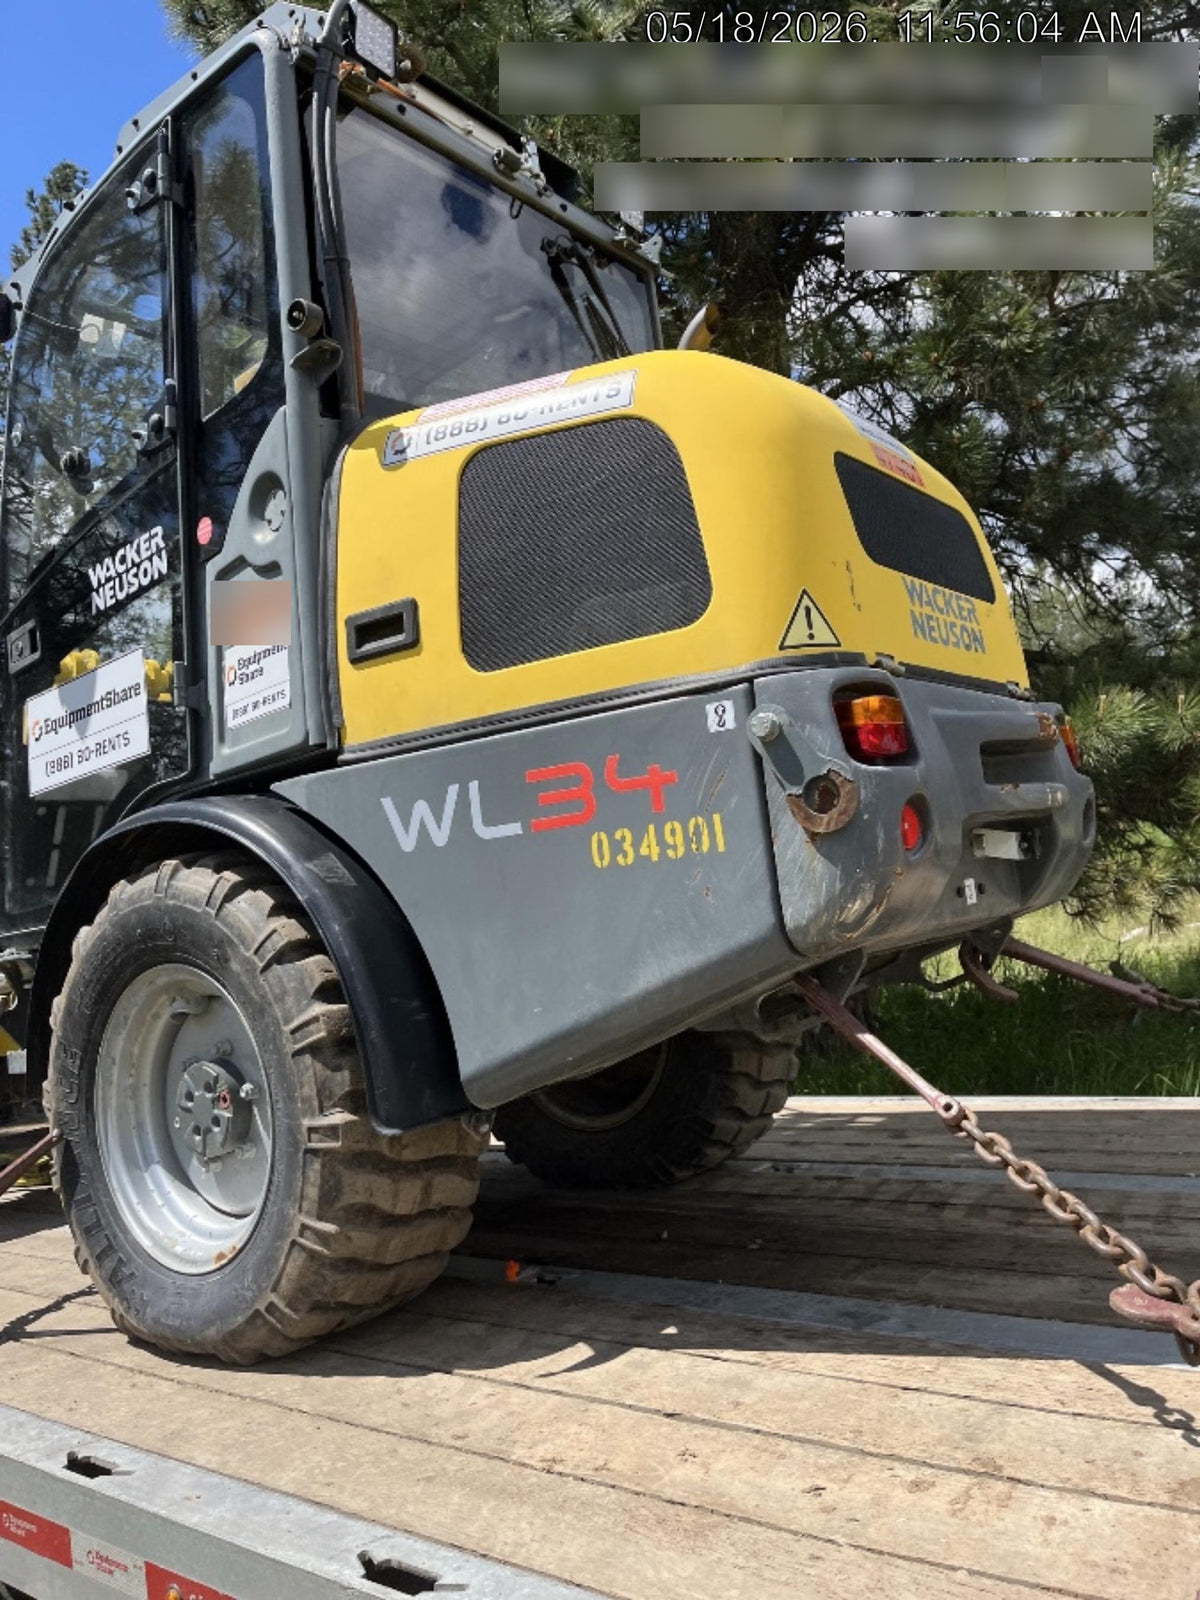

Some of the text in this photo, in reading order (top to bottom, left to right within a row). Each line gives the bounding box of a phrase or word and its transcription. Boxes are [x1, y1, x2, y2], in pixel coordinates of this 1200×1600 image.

[88, 525, 166, 590] WACKER
[91, 549, 168, 616] NEUSON
[901, 575, 981, 627] WACKER
[910, 608, 986, 655] NEUSON
[43, 681, 142, 736] EquipmentShare
[380, 754, 677, 852] WL34
[591, 813, 726, 869] 034901
